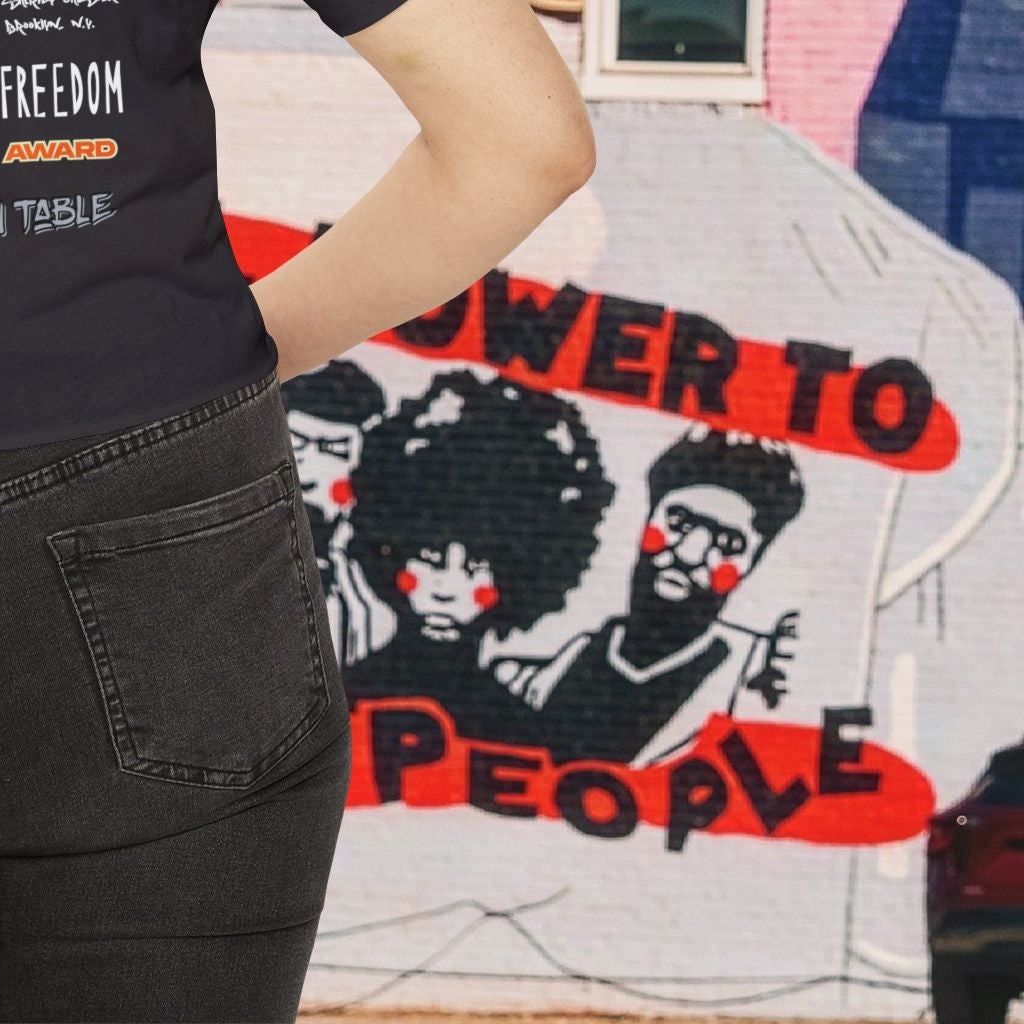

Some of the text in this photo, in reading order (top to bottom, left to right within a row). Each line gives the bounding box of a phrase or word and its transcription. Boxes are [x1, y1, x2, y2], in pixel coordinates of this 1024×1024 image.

[0, 60, 124, 119] FREEDOM
[1, 138, 118, 164] AWARD
[13, 191, 119, 234] TABLE
[783, 339, 934, 454] TO
[368, 707, 882, 854] PEOPLE
